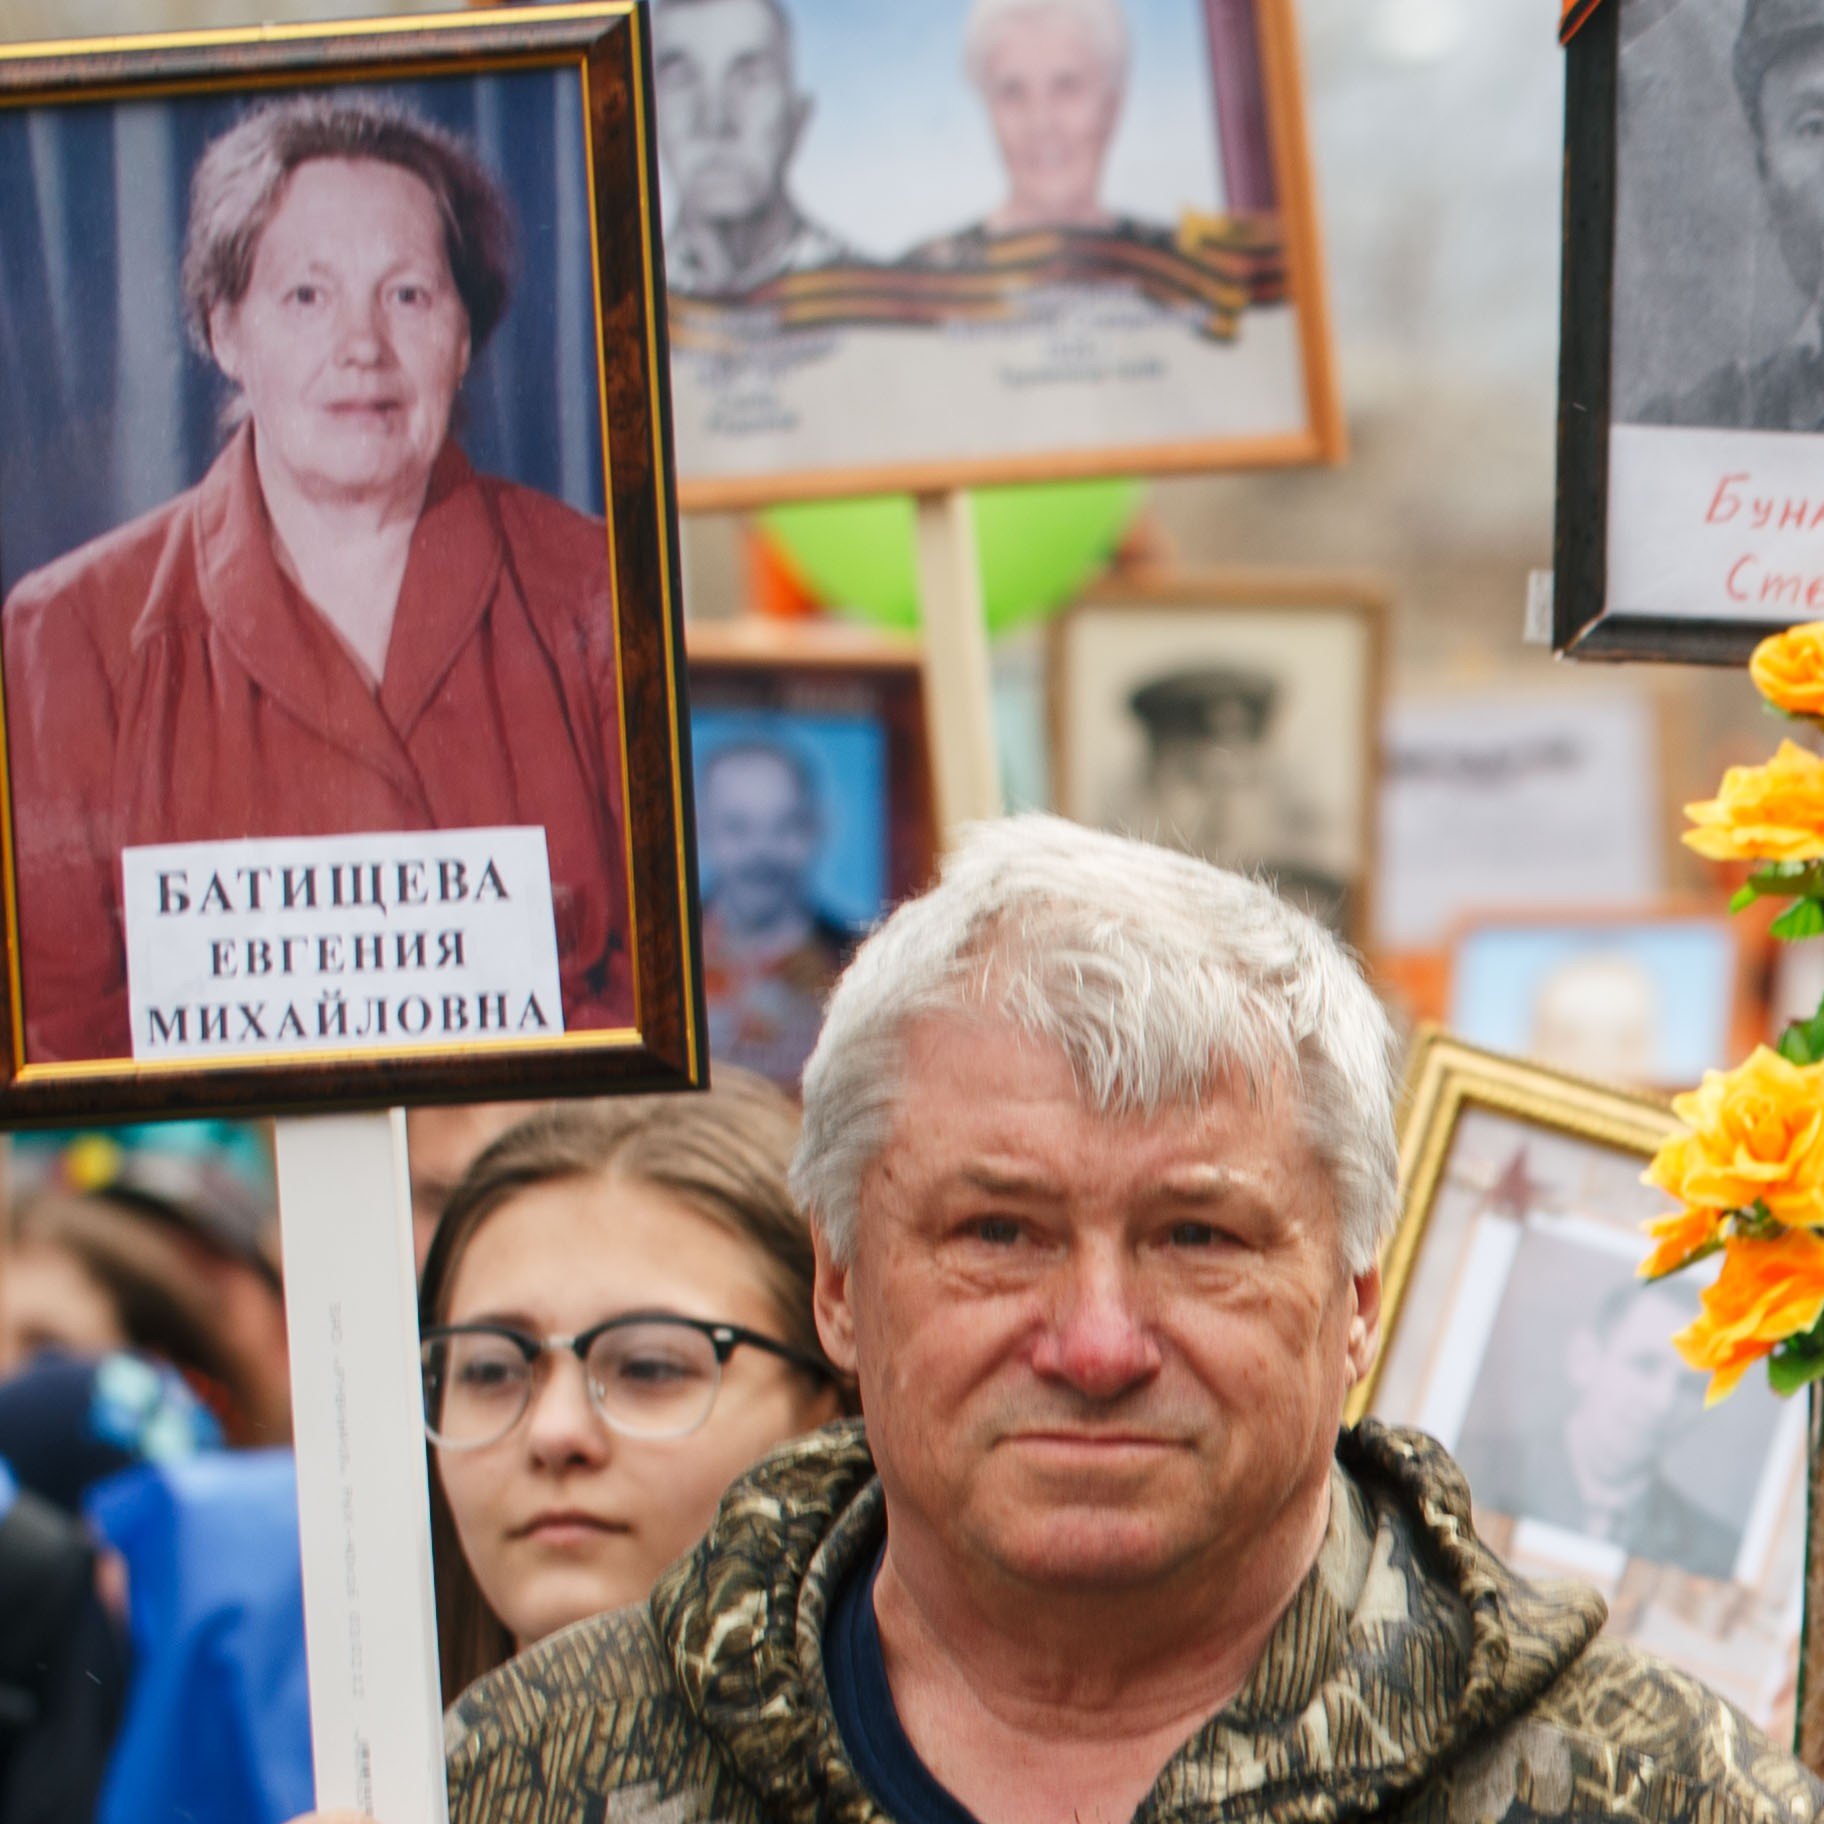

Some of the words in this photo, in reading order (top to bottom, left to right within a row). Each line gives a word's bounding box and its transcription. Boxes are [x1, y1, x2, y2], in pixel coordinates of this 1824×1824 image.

[157, 857, 510, 916] БАТИЩЕВА
[210, 929, 466, 979] ЕВГЕНИЯ
[147, 989, 551, 1047] МИХАЙЛОВНА
